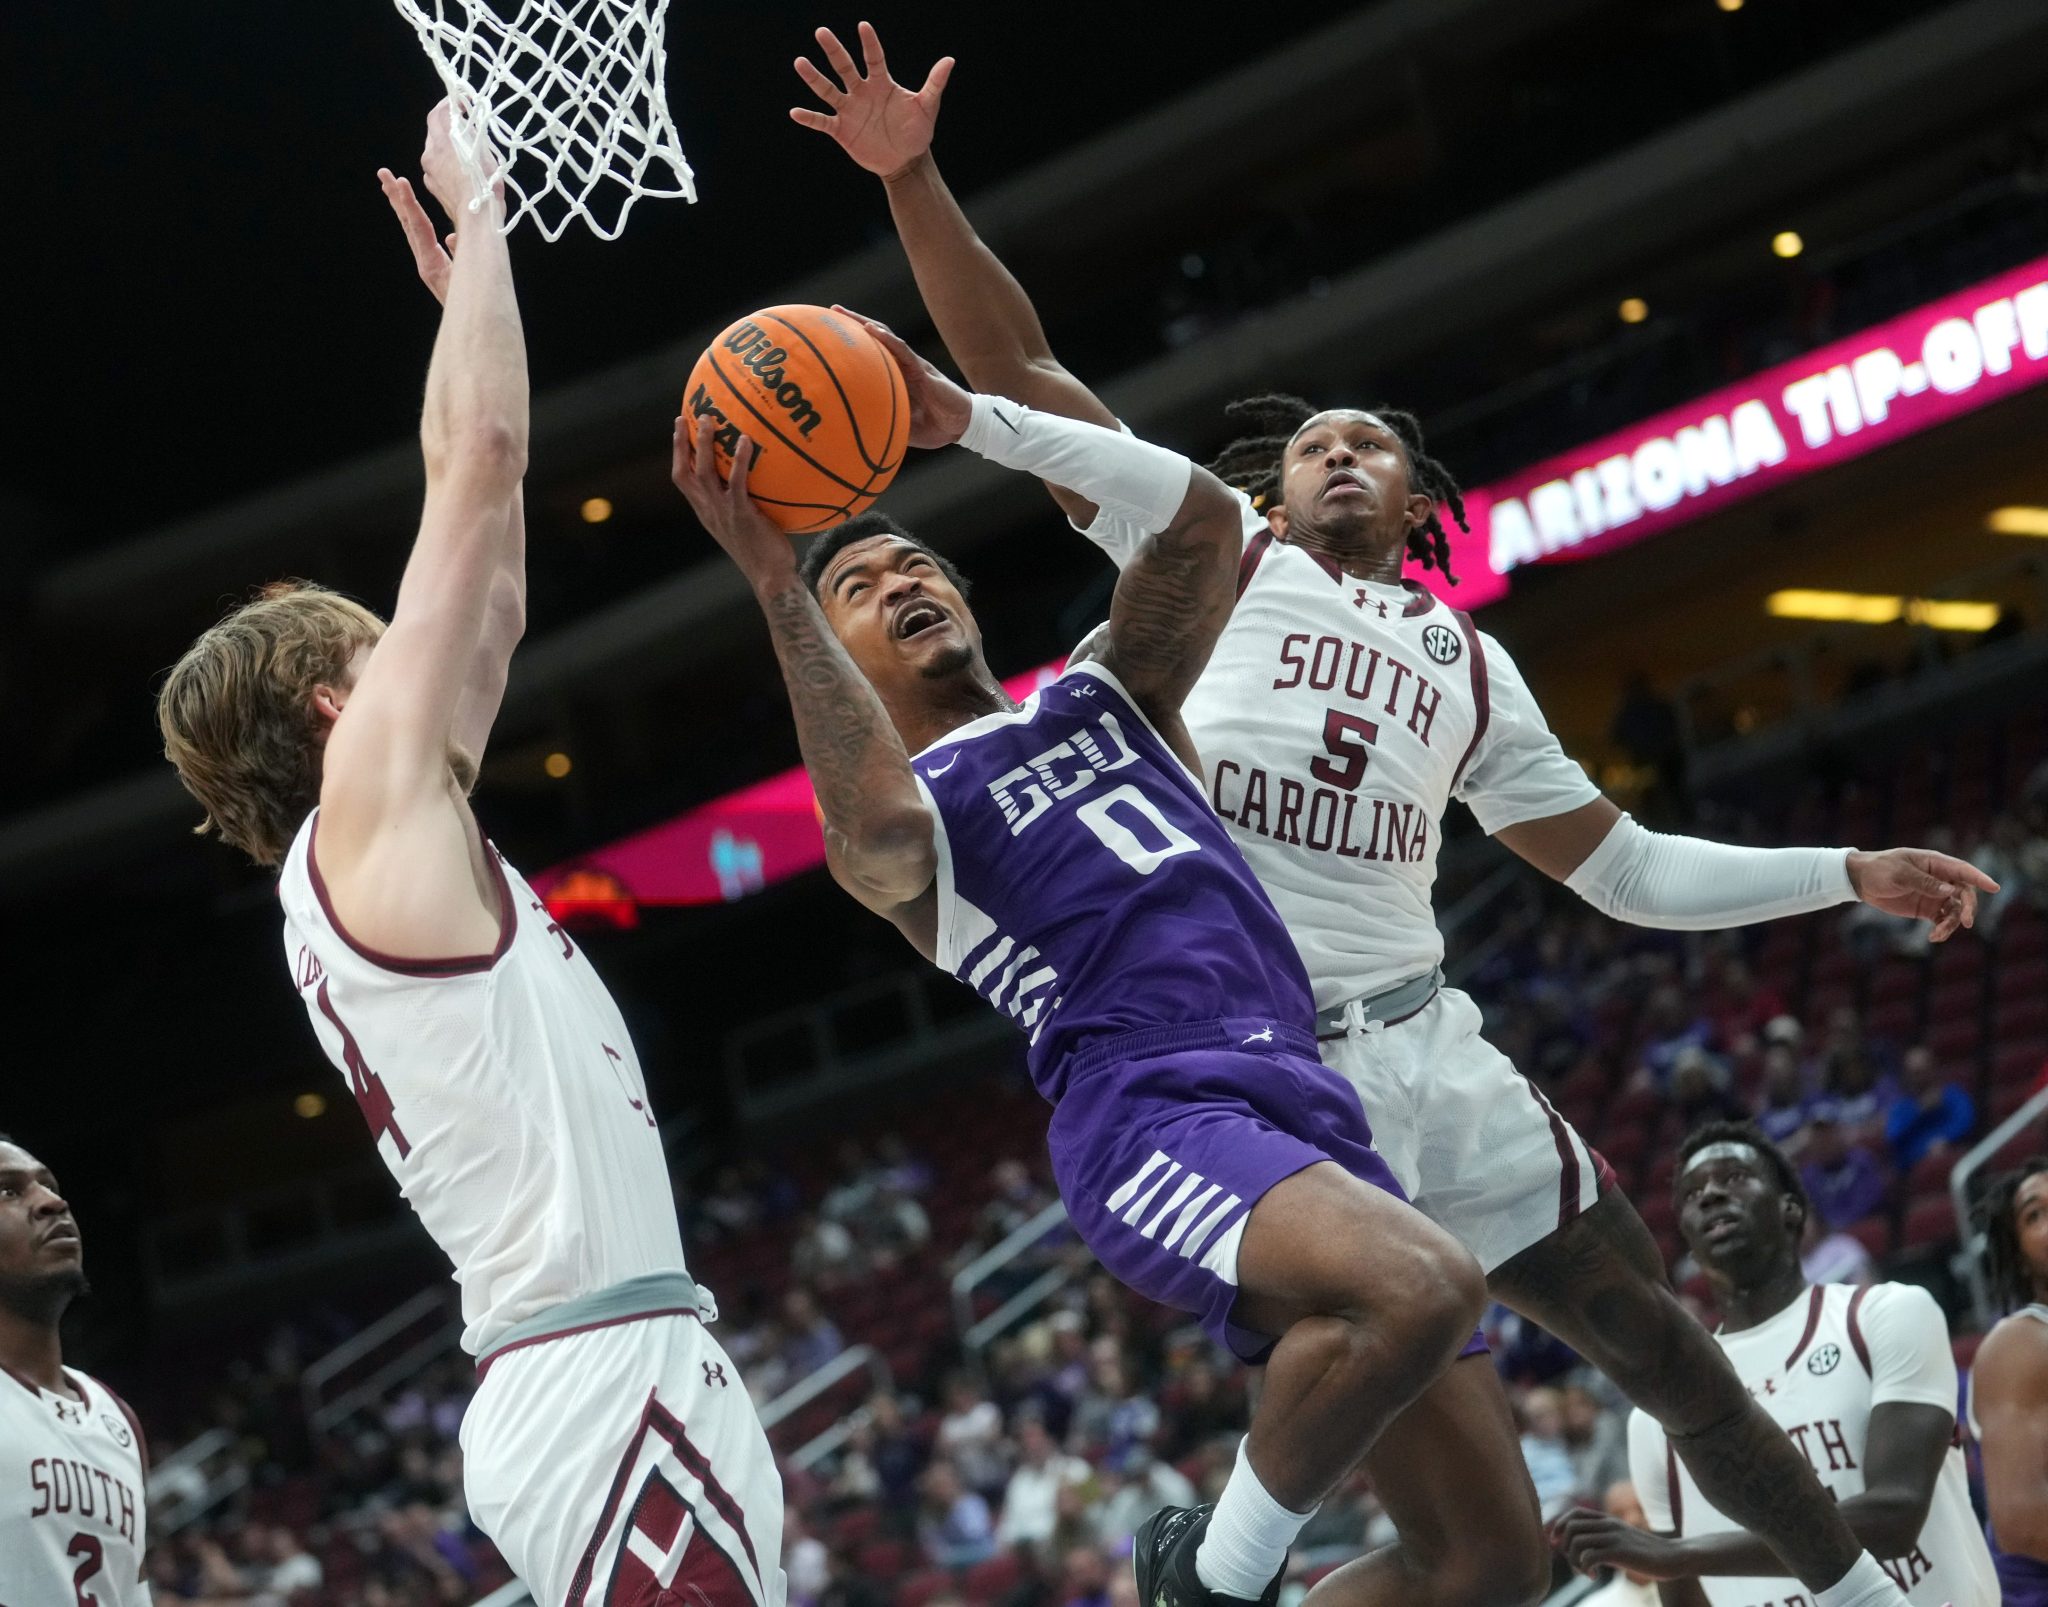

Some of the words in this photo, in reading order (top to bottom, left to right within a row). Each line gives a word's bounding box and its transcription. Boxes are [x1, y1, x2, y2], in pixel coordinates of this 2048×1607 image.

[722, 321, 823, 438] Wilson
[1488, 400, 1787, 575] ARIZONA
[1782, 280, 2048, 449] TIP-OFF
[1273, 633, 1442, 748] SOUTH
[1423, 625, 1461, 664] SEC
[986, 711, 1141, 837] GCU
[1309, 707, 1379, 791] 5
[1076, 783, 1202, 875] 0
[1213, 759, 1427, 863] CAROLINA
[31, 1458, 135, 1546] SOUTH
[67, 1532, 103, 1607] 2
